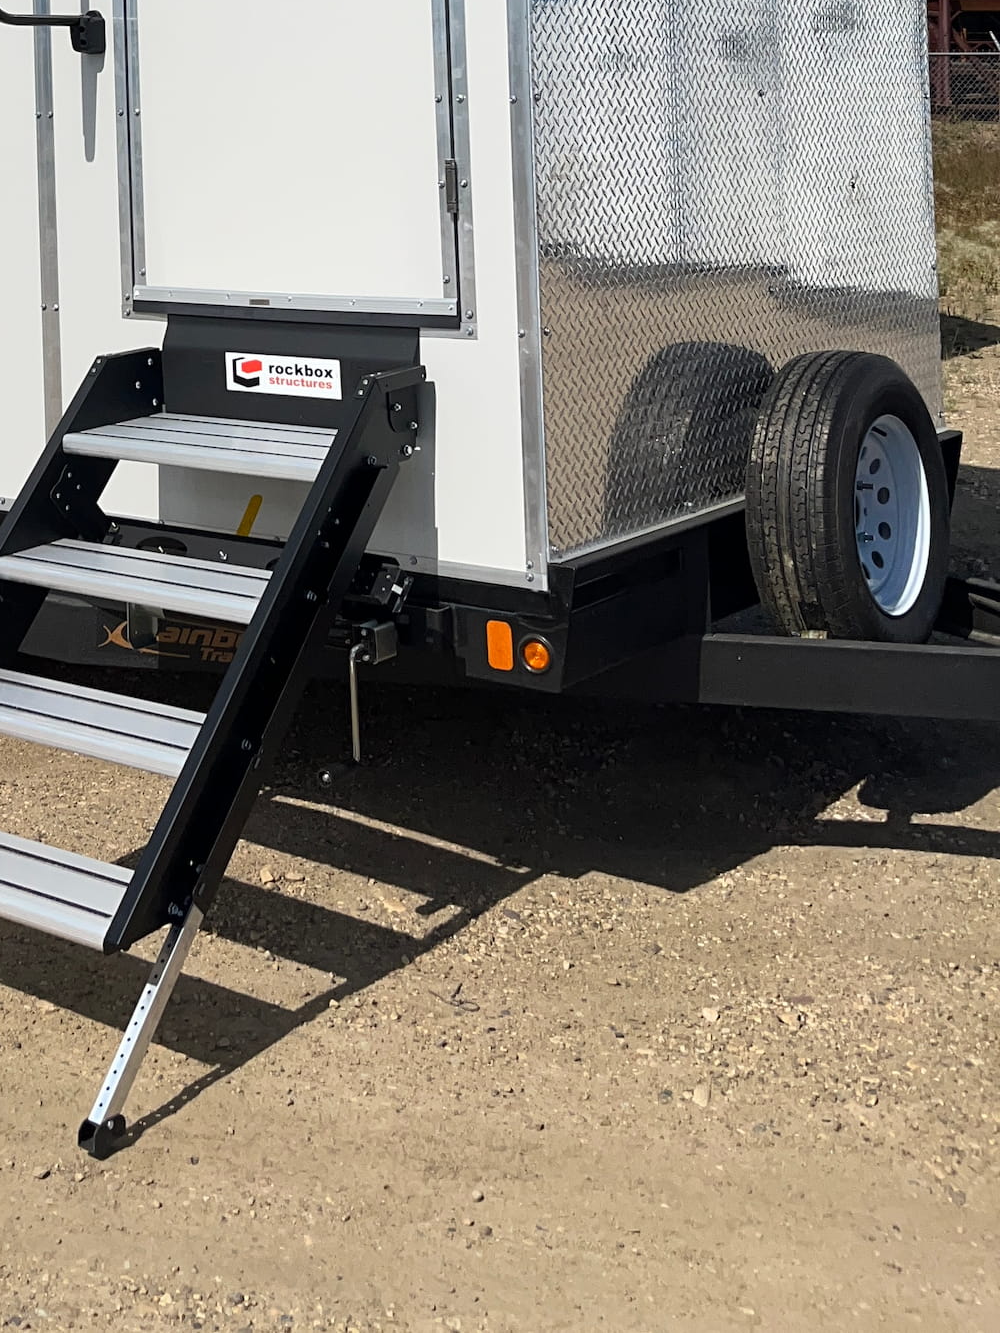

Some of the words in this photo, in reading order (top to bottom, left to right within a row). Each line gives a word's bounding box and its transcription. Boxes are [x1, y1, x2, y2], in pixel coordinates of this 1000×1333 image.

[268, 364, 333, 379] rockbox
[269, 376, 333, 389] structures
[156, 625, 243, 649] ainb
[201, 647, 235, 664] Tra
